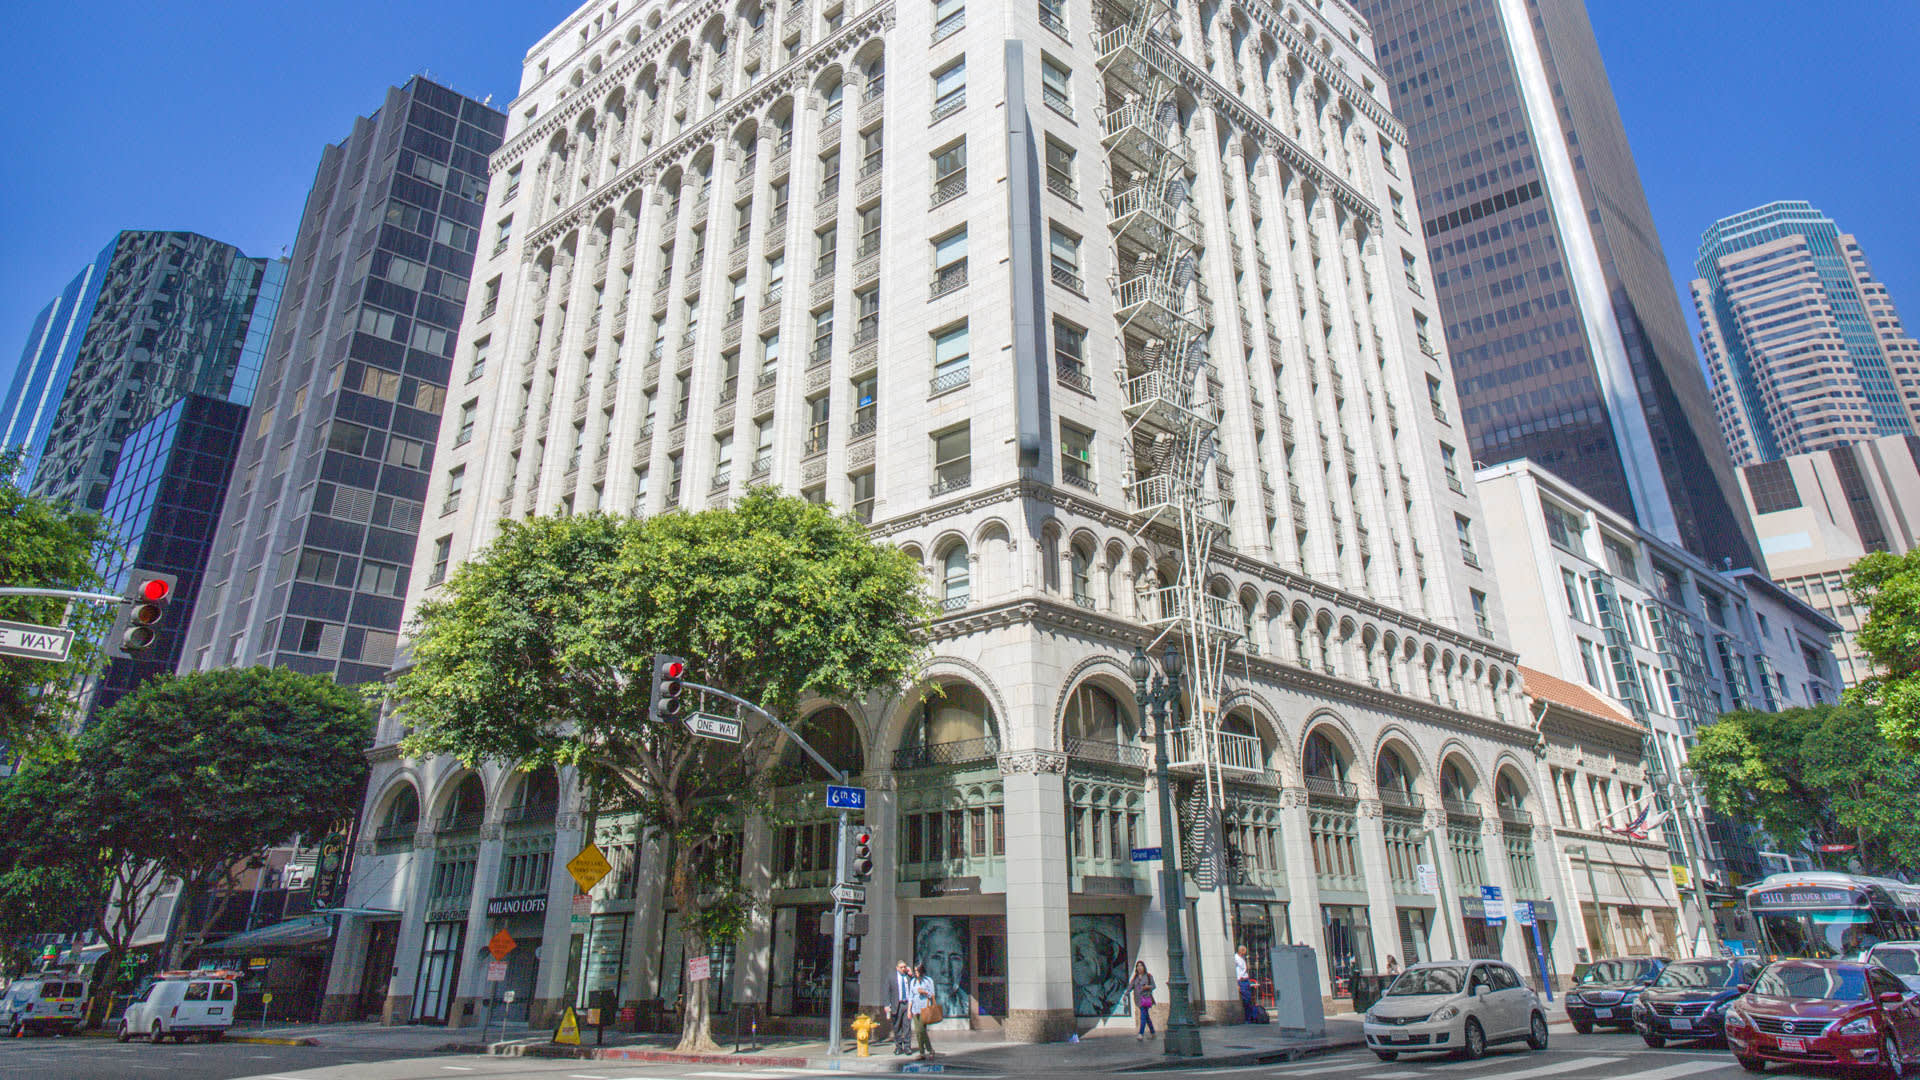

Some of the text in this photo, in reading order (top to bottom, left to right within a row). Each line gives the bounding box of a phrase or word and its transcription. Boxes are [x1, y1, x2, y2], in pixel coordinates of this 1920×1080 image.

[20, 632, 59, 650] WAY
[697, 719, 737, 735] ONE WAY
[831, 789, 862, 805] 6th St
[841, 890, 852, 898] ONE
[1760, 892, 1784, 904] 910
[1791, 893, 1820, 902] SILVER
[488, 899, 546, 914] MILANO LOFTS
